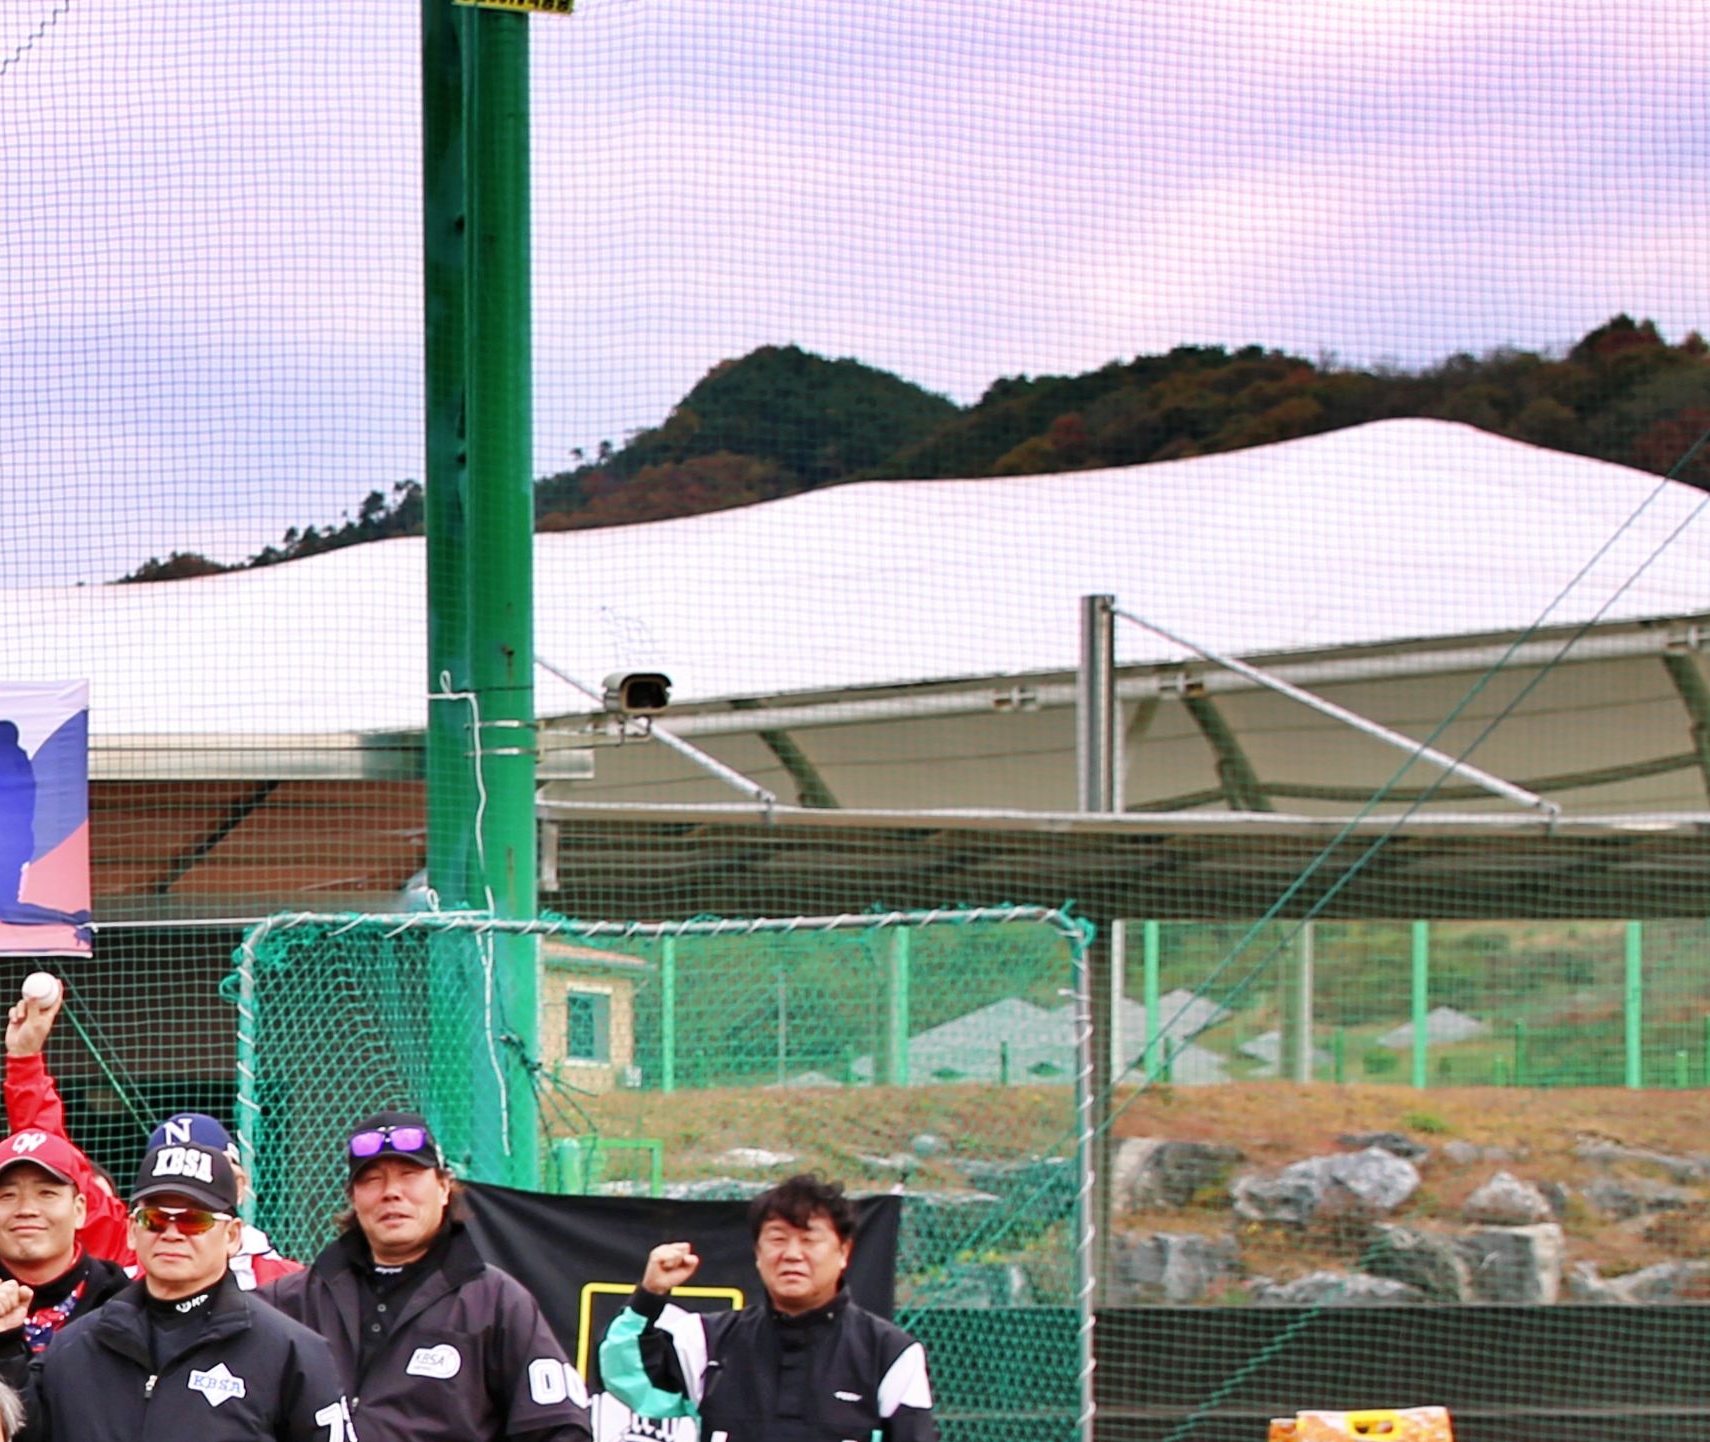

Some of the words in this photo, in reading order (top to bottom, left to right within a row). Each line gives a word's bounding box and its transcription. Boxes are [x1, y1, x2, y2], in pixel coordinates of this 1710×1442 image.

[163, 1118, 193, 1146] N
[151, 1146, 214, 1184] KBSA
[192, 1374, 243, 1395] KBSA
